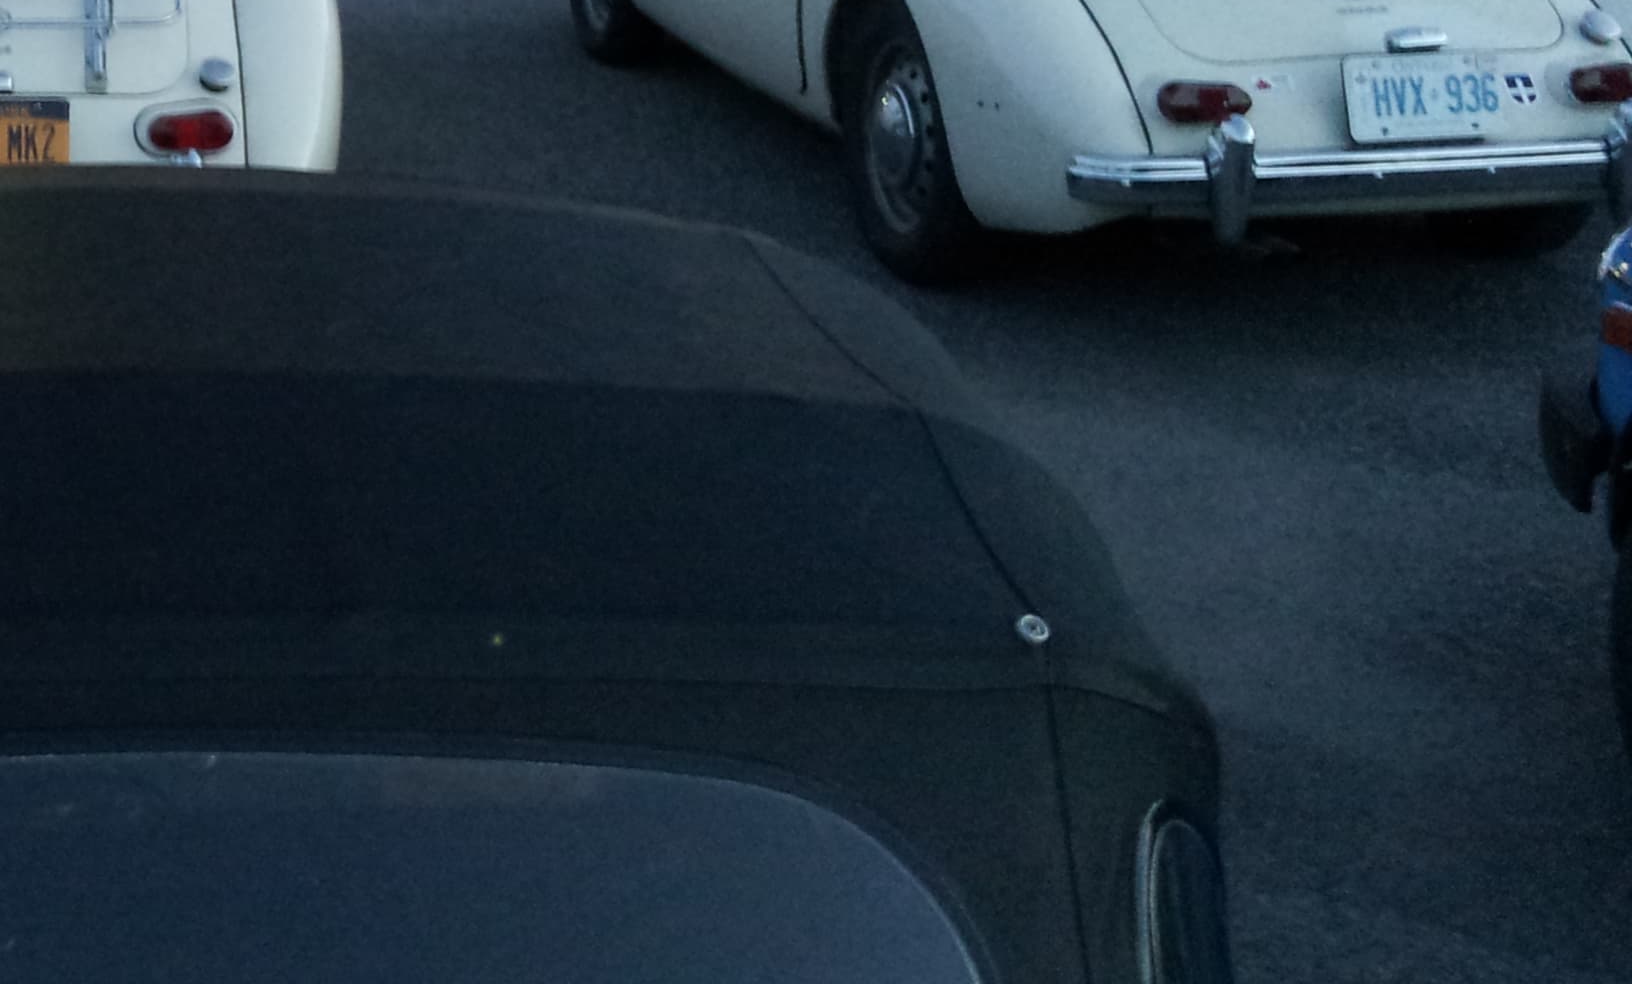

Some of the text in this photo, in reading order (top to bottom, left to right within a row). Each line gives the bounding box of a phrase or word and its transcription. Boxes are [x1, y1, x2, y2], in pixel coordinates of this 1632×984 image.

[1372, 72, 1499, 117] HVX 936
[7, 122, 57, 163] MK2
